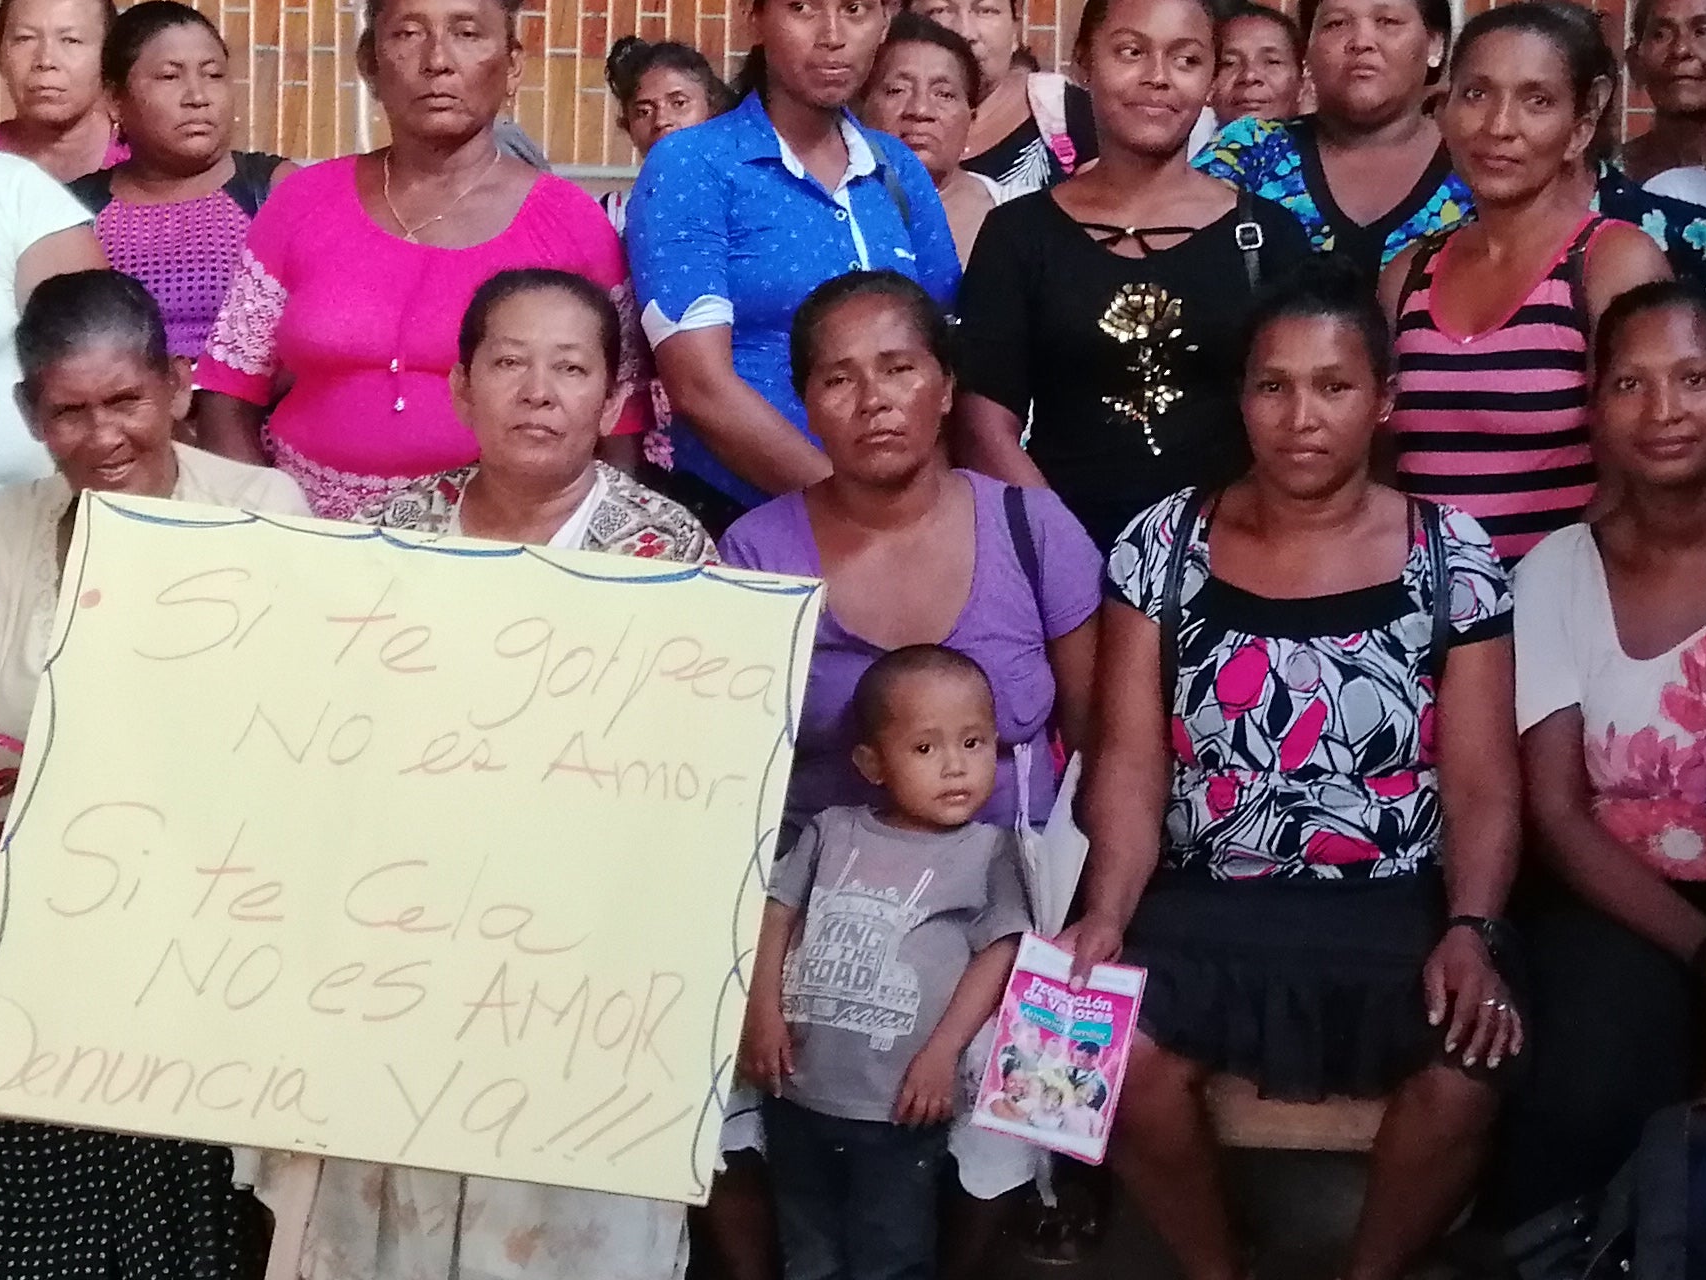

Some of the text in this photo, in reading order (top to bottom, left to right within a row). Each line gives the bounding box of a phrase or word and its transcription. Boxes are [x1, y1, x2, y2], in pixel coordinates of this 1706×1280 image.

[133, 568, 777, 739] Si te golpea
[398, 730, 508, 777] es
[45, 802, 166, 917] Si
[192, 820, 286, 922] te
[814, 918, 884, 951] KING
[841, 945, 879, 966] THE
[801, 957, 877, 991] ROAD
[1030, 975, 1114, 1012] Promoción
[454, 960, 686, 1081] AMOR
